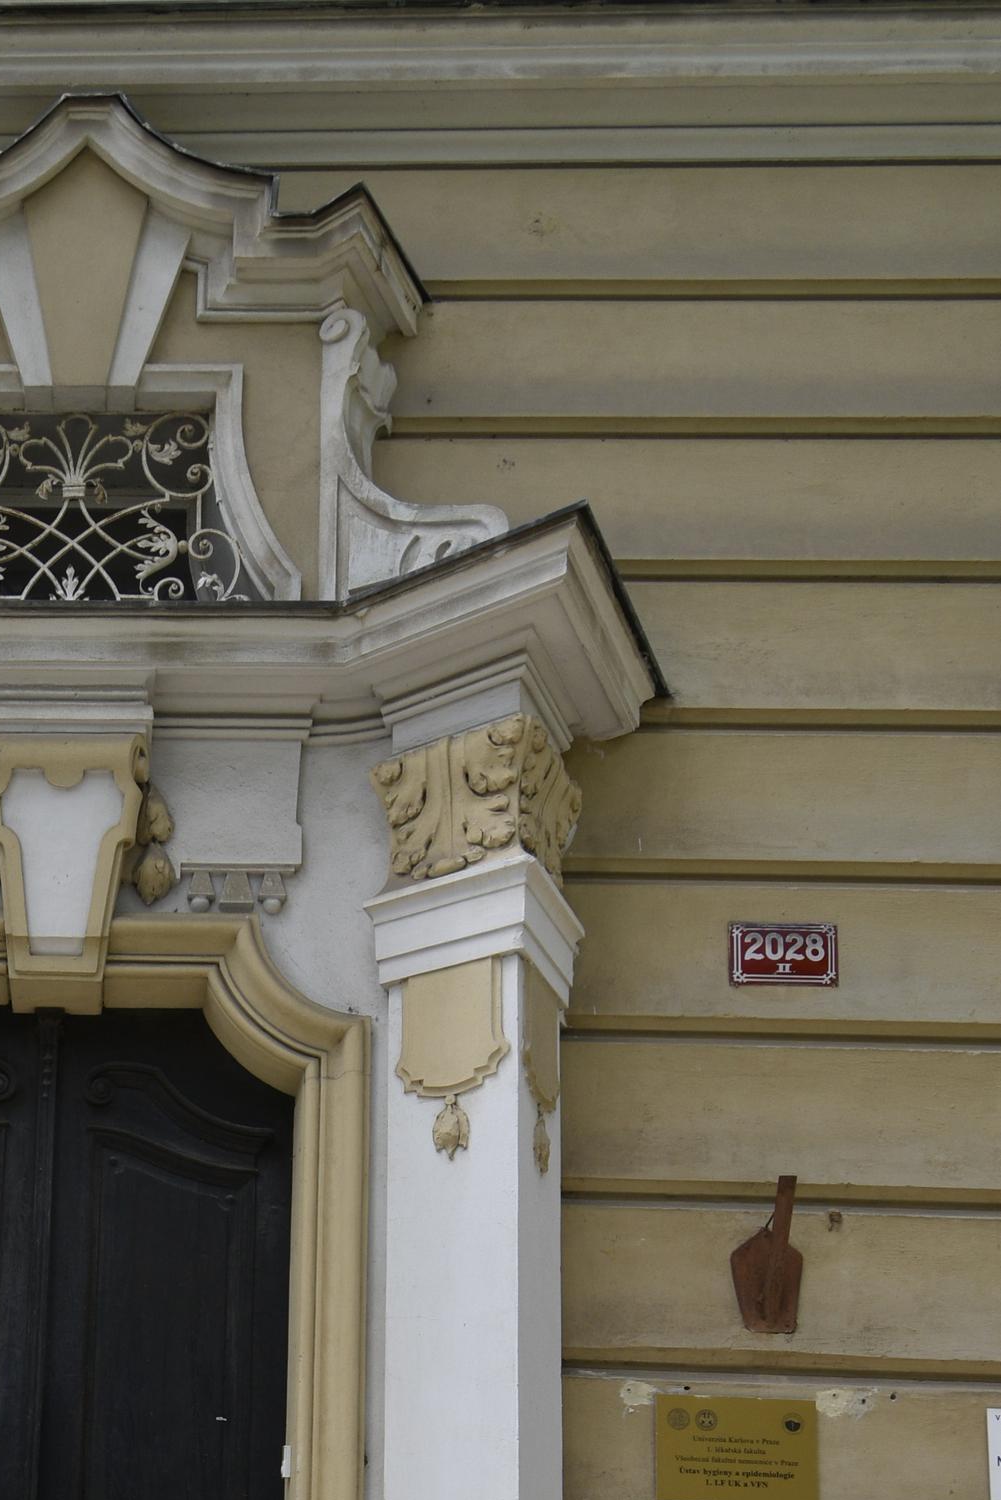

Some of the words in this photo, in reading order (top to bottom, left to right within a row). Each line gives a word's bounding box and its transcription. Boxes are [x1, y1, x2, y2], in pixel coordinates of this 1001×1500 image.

[744, 932, 825, 962] 2028
[729, 1437, 754, 1445] Karlova
[762, 1438, 780, 1446] Praze
[743, 1447, 766, 1455] fakulta
[679, 1466, 700, 1474] Ústav
[703, 1468, 732, 1477] hygieny
[742, 1470, 795, 1480] epidemiologie
[728, 1479, 741, 1487] UK
[750, 1480, 768, 1488] VFN
